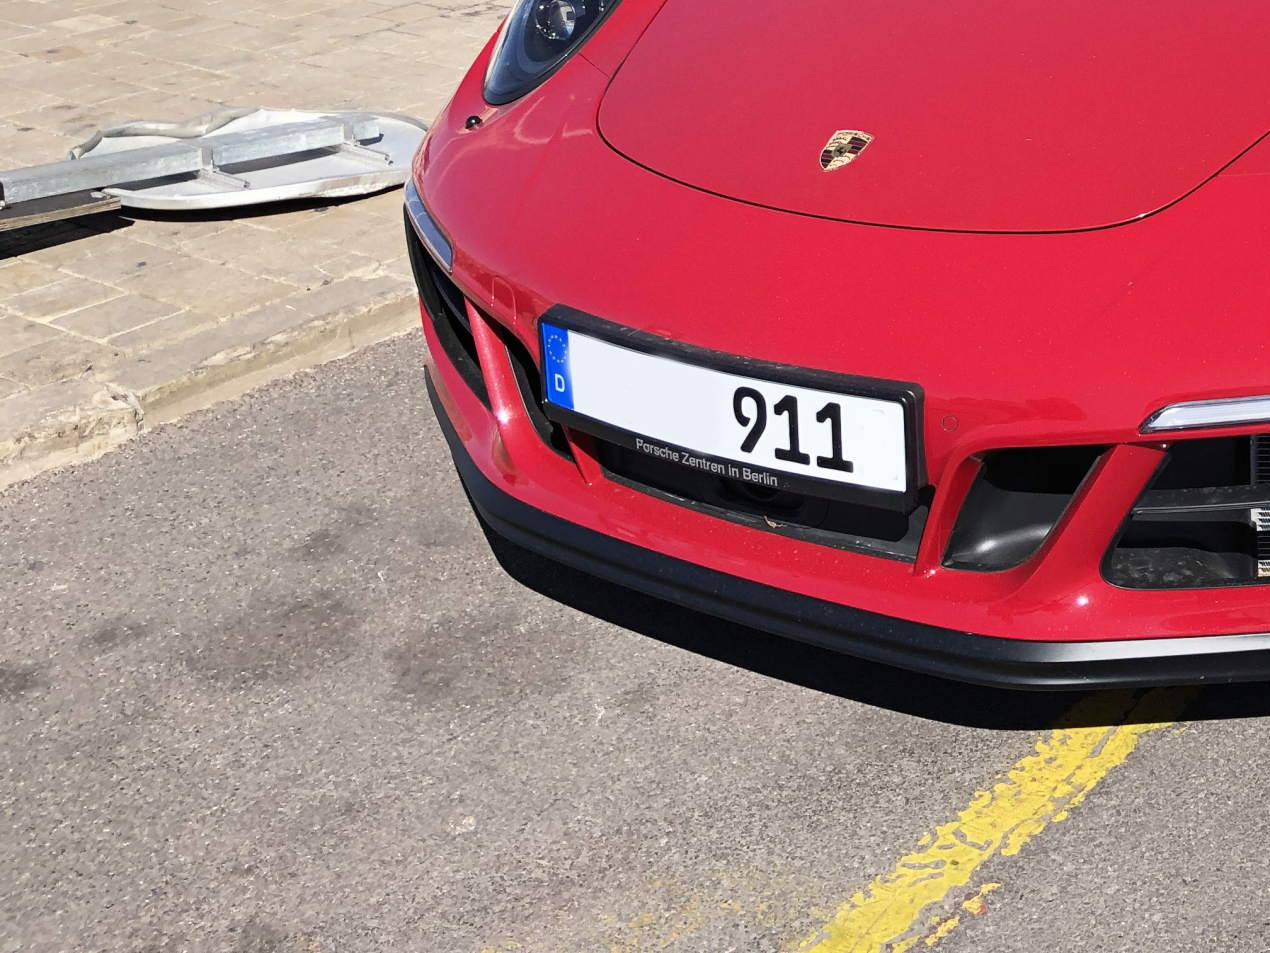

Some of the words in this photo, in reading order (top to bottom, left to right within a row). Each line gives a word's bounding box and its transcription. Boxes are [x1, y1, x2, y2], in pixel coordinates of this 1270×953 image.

[554, 373, 566, 392] D
[732, 386, 854, 473] 911
[635, 438, 680, 462] Porsche
[681, 452, 726, 475] Zentren
[728, 464, 739, 478] in
[742, 468, 778, 487] Berlin
